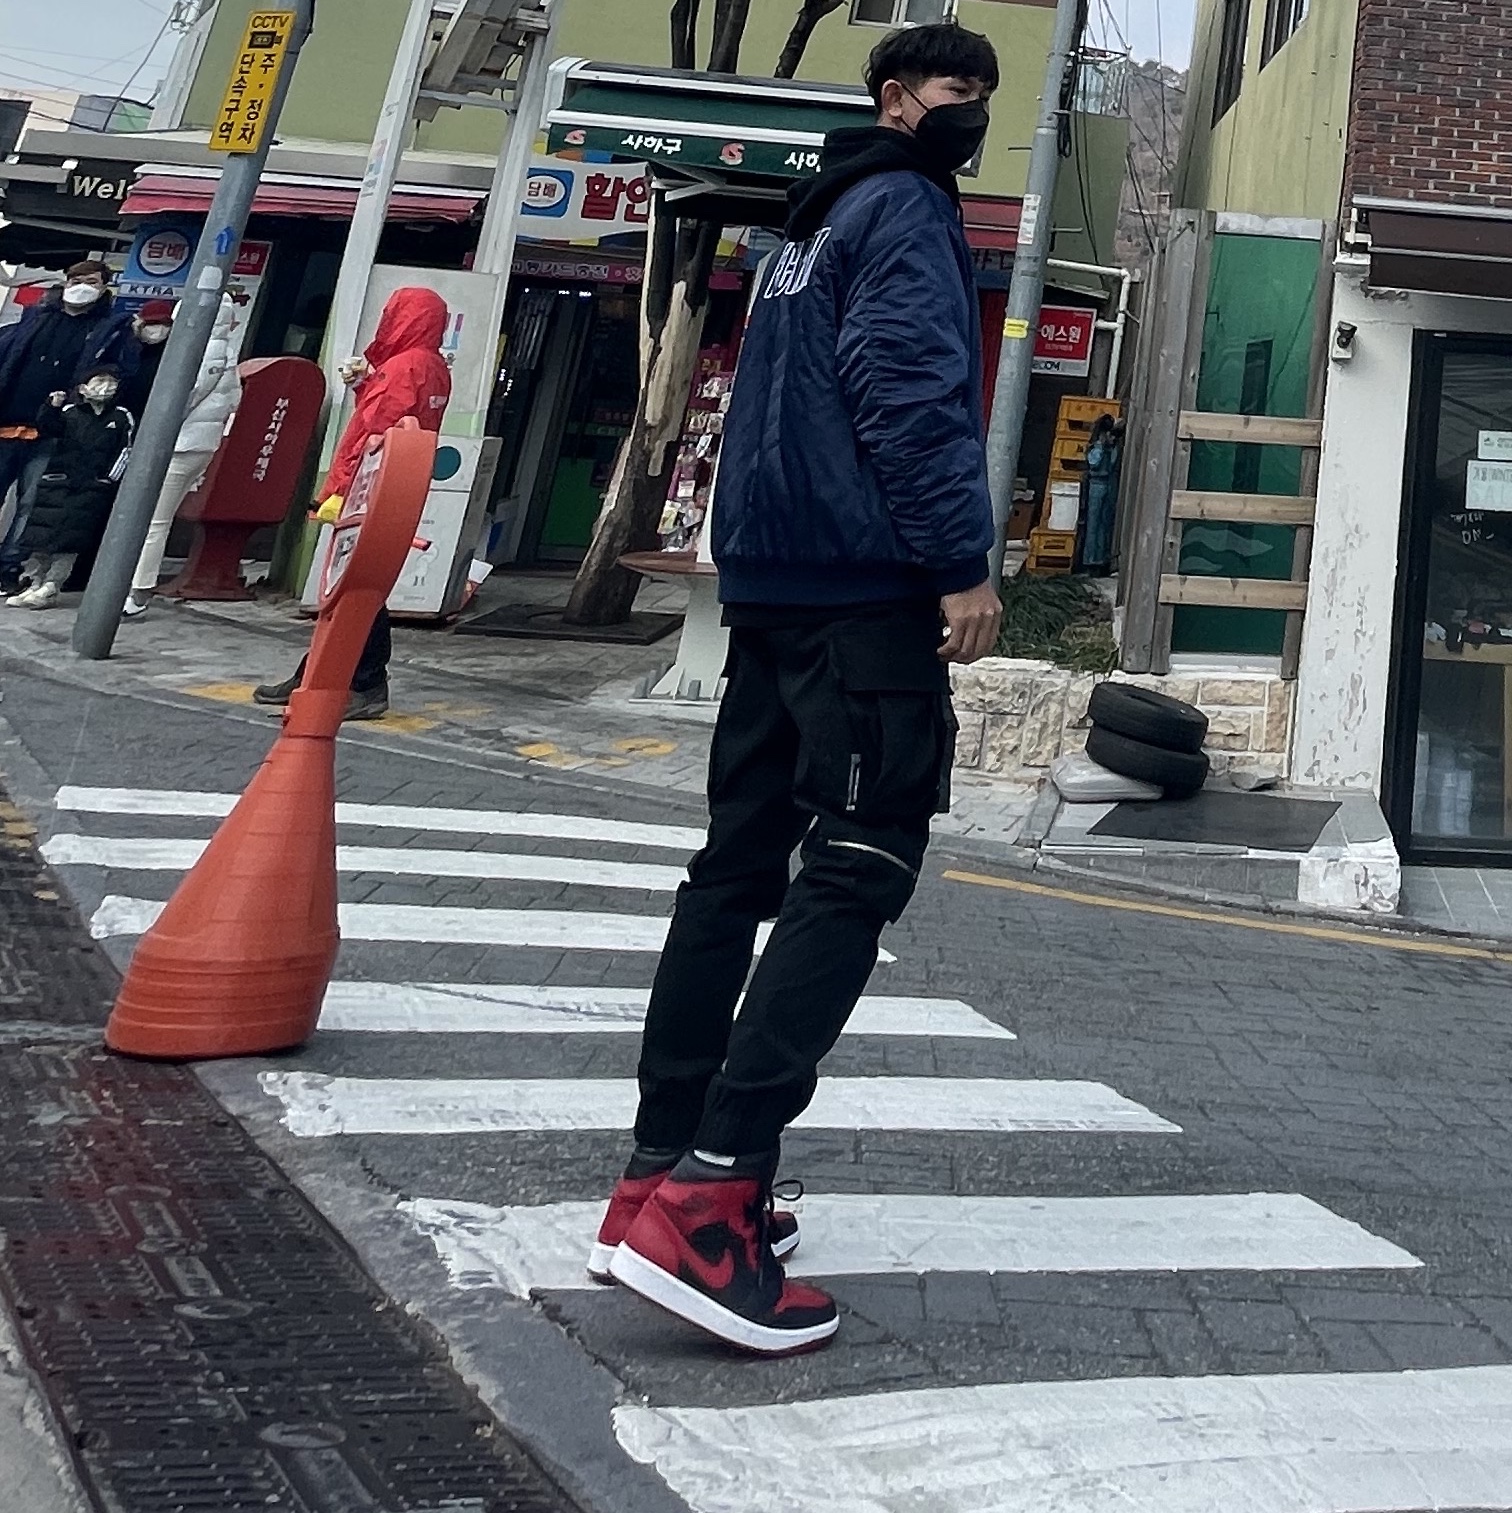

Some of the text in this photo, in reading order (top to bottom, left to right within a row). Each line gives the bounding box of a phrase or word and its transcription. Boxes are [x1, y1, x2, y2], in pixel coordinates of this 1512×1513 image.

[251, 15, 290, 29] CCTV
[621, 133, 683, 156] 사하구
[72, 175, 127, 199] Wel
[147, 241, 188, 261] 담배
